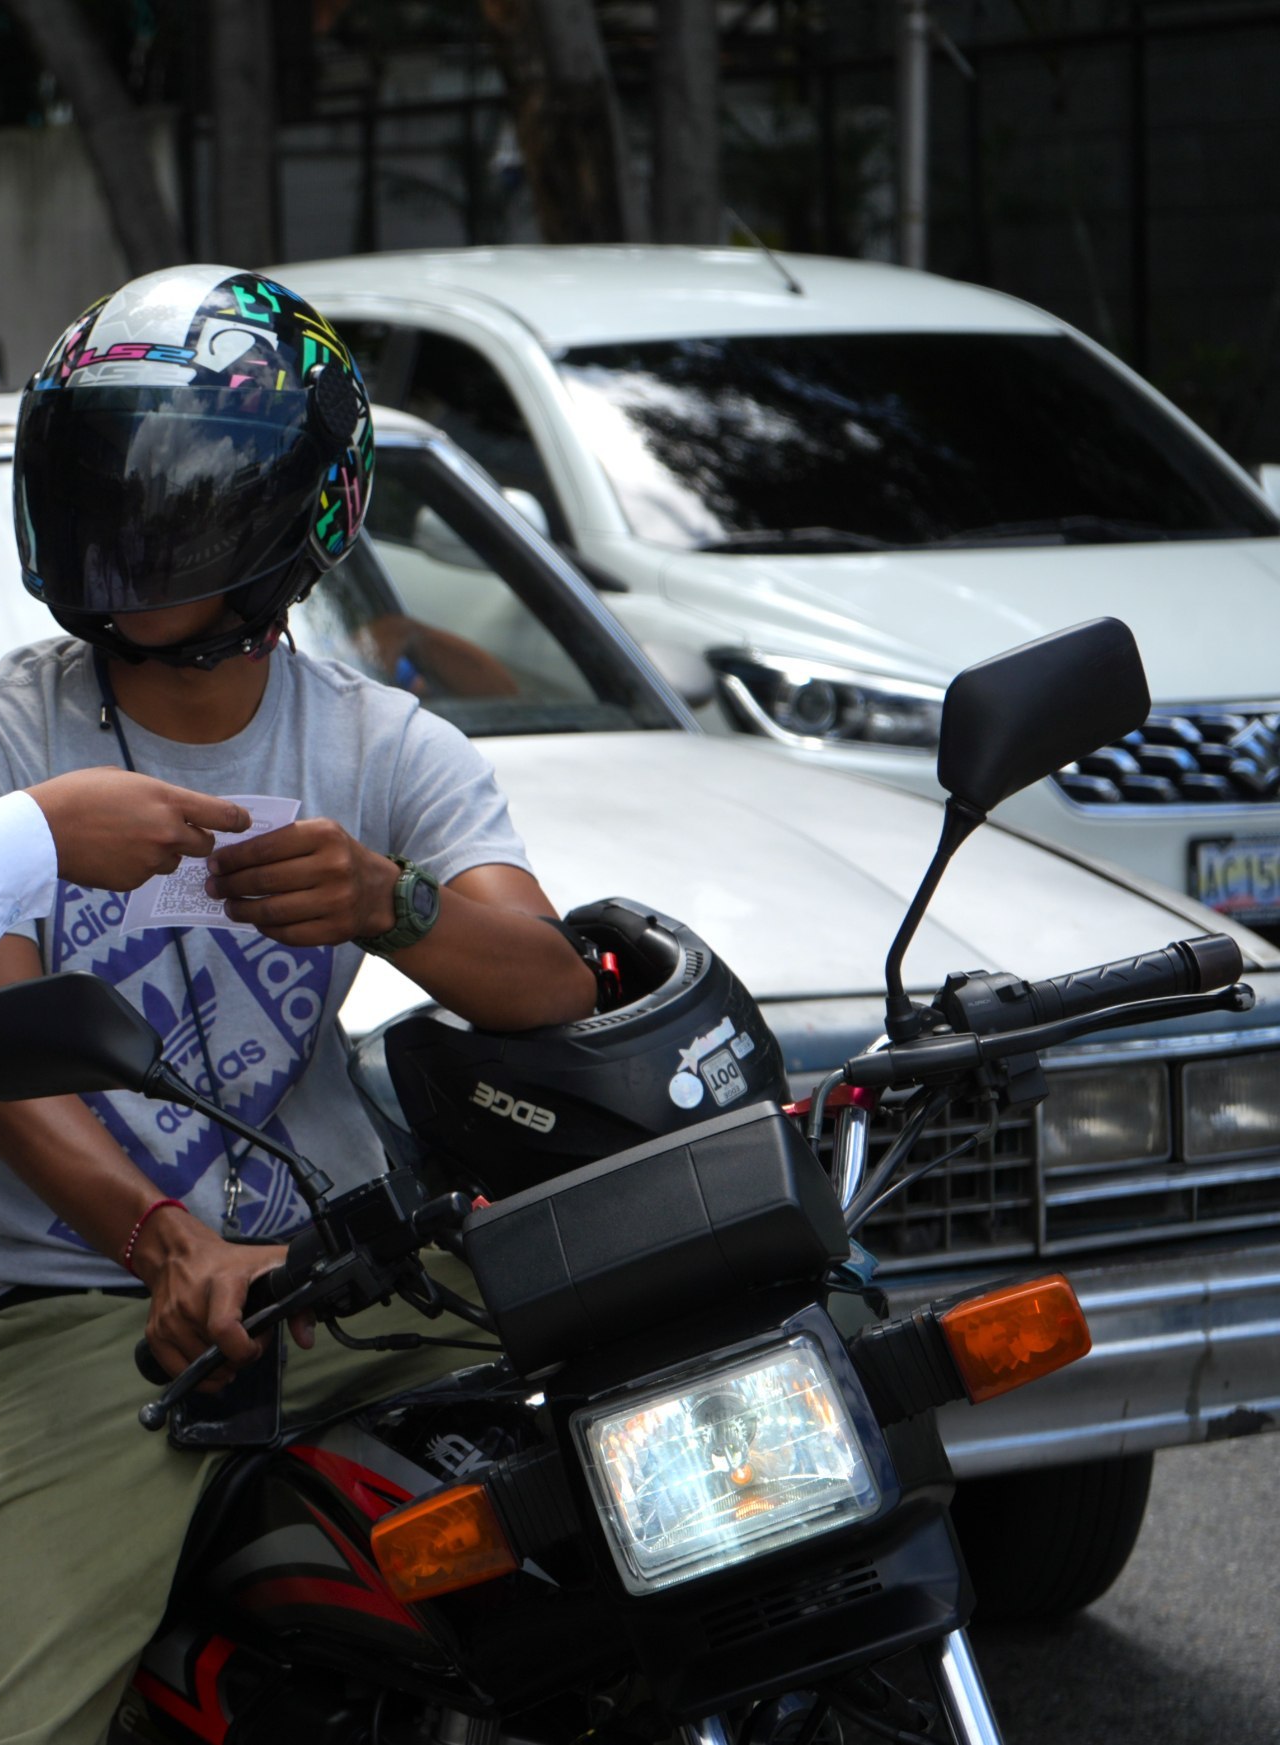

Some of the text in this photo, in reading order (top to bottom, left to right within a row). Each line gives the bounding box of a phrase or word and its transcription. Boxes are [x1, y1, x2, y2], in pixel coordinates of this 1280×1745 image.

[76, 342, 198, 368] LS2
[710, 1062, 739, 1092] DOT
[471, 1081, 557, 1133] EDGE
